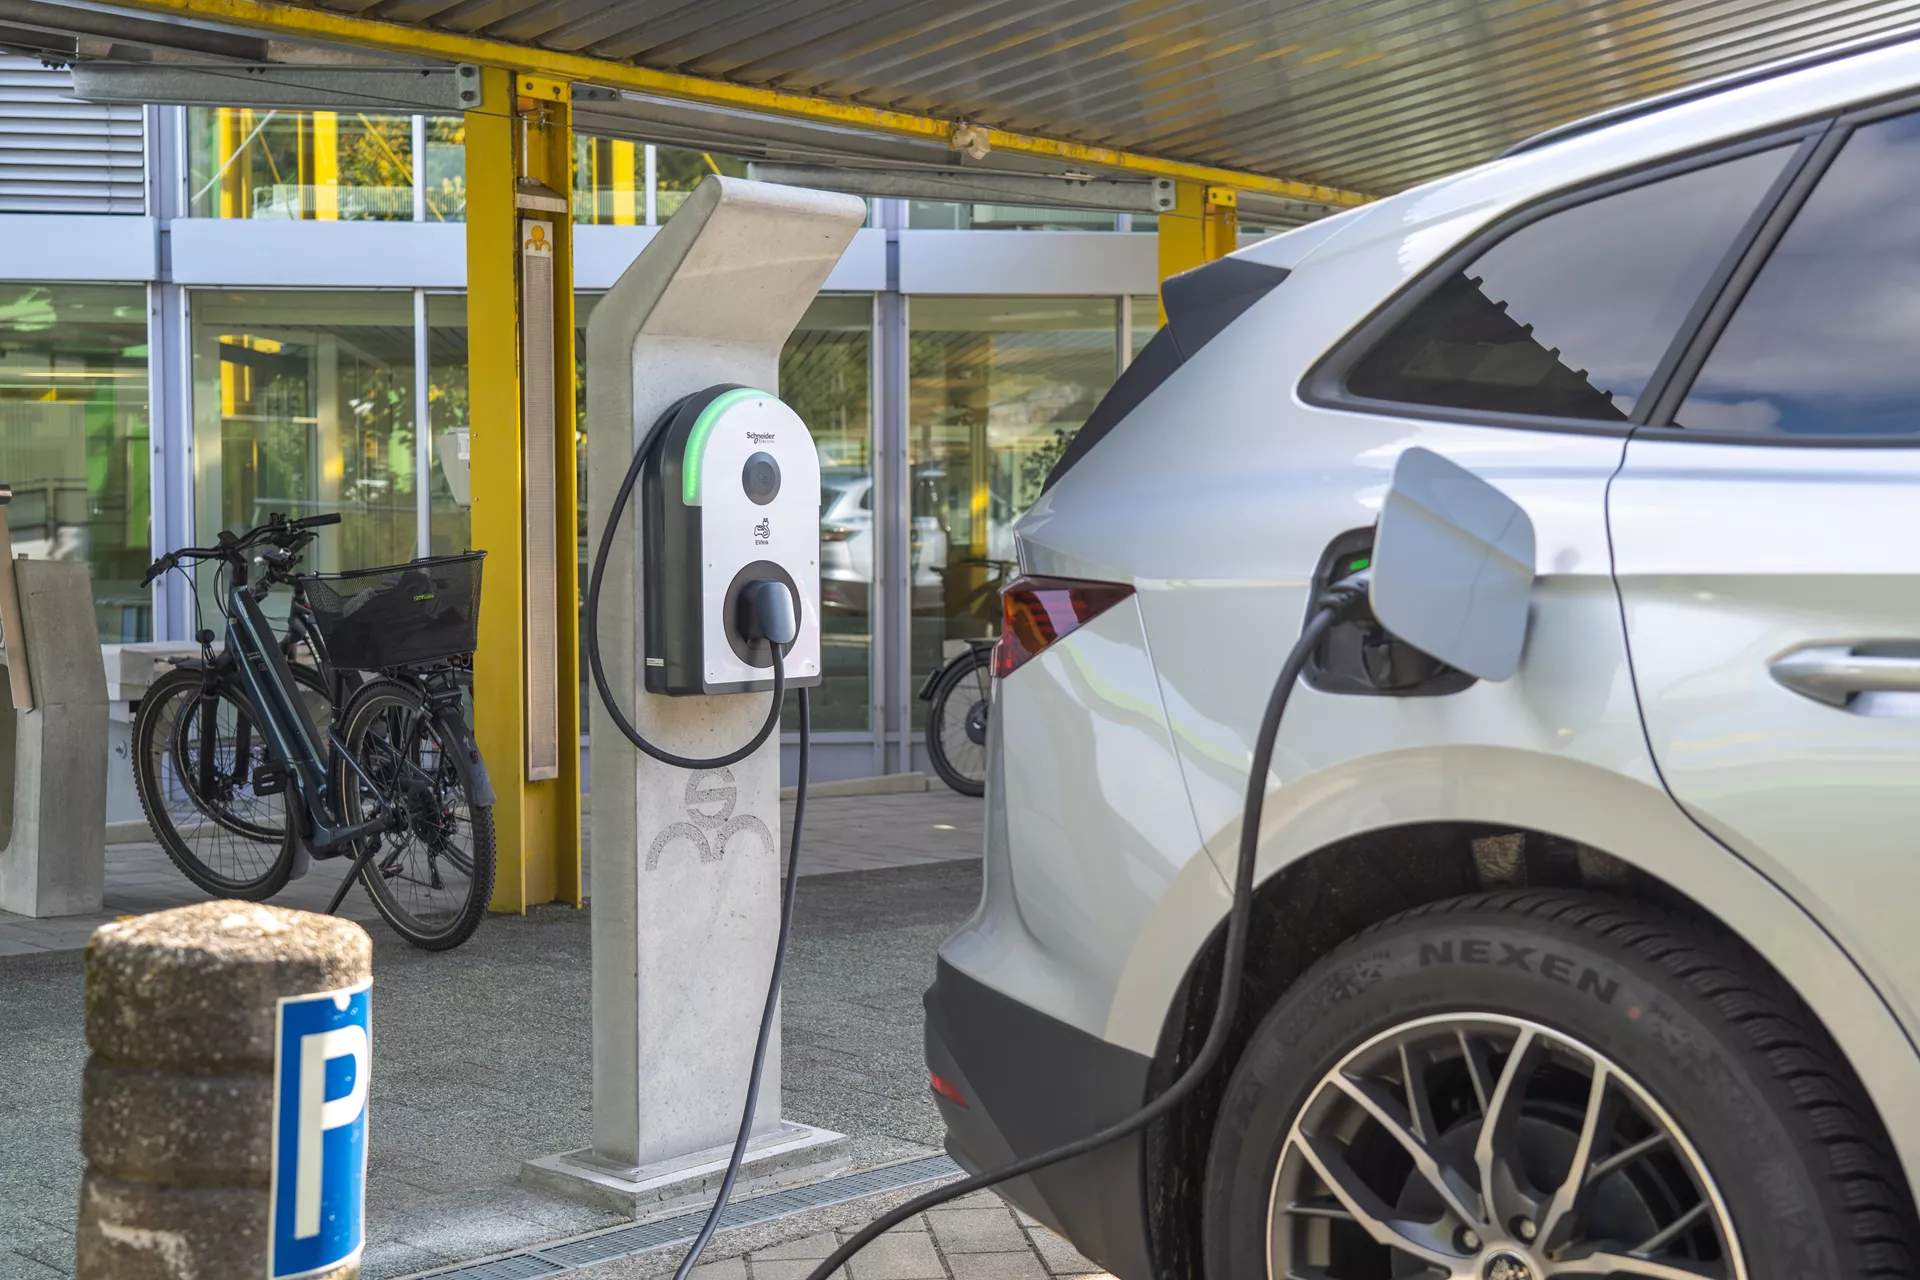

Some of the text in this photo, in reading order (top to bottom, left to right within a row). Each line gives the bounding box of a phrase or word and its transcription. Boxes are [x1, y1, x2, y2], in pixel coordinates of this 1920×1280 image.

[746, 431, 775, 444] Schneider
[1418, 938, 1620, 1005] NEXEN
[294, 1024, 368, 1240] P
